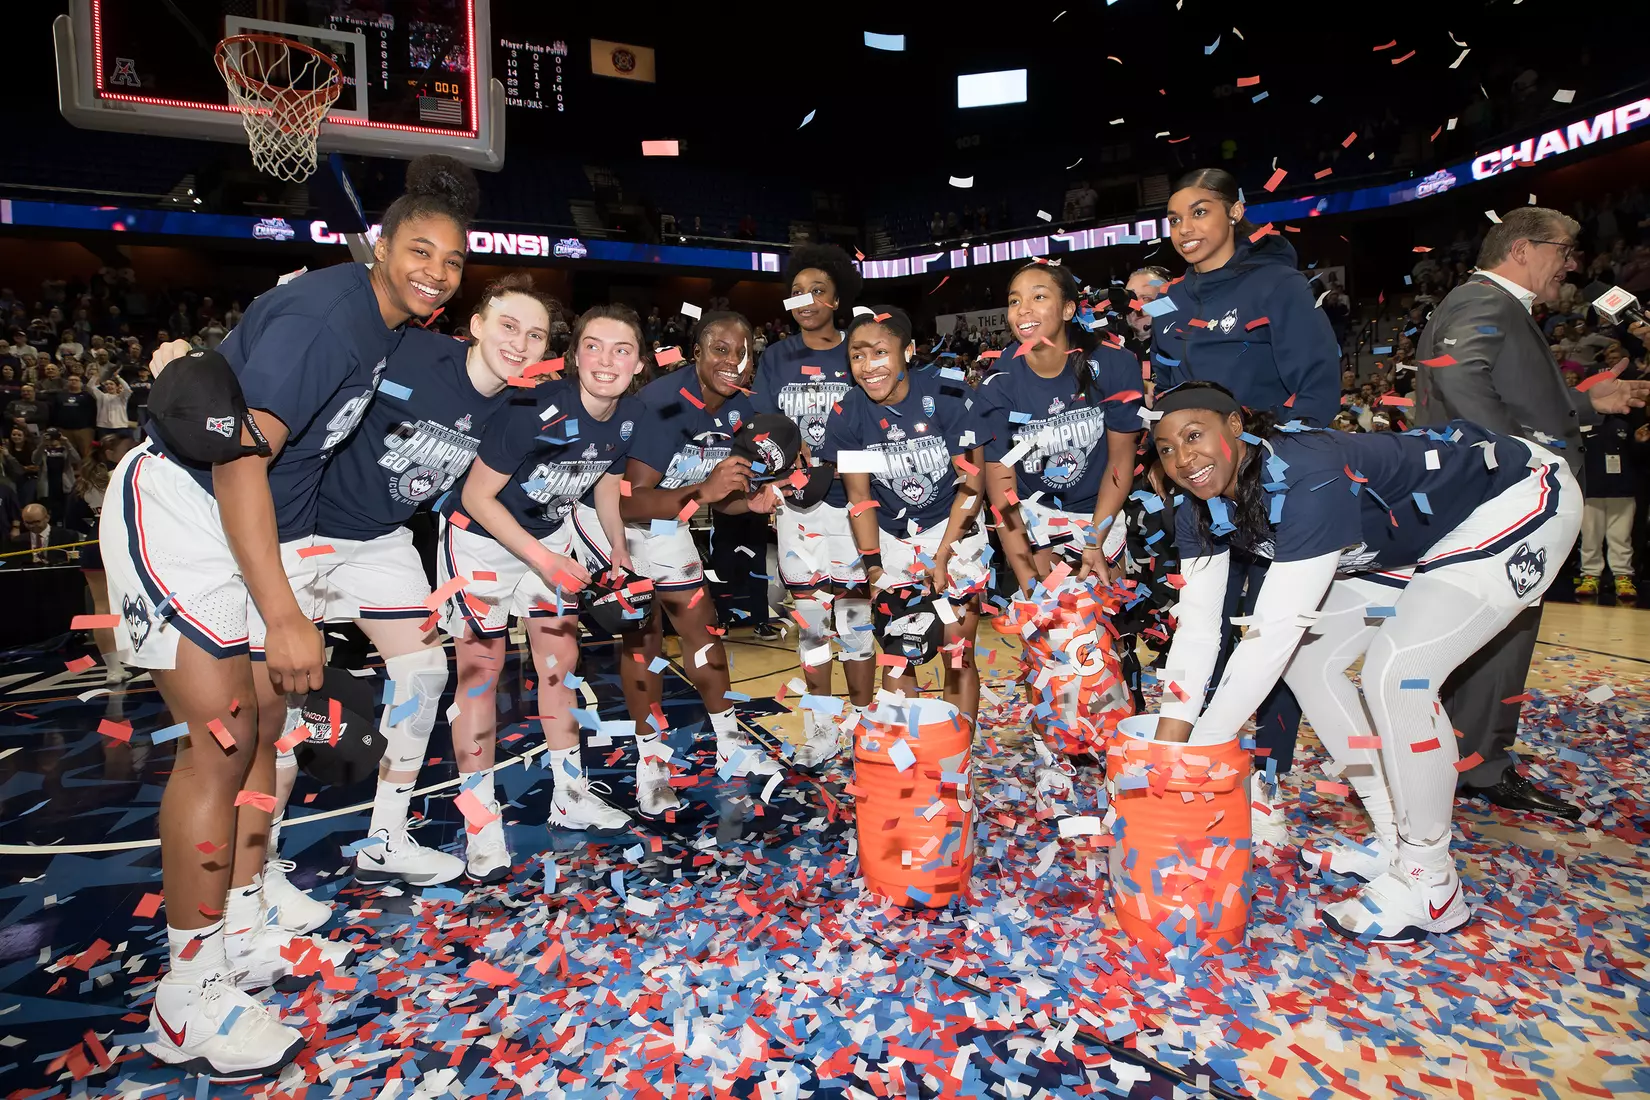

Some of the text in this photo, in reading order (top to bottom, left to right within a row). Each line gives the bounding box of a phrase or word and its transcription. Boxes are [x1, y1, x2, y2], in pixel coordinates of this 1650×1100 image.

[380, 30, 387, 39] 0
[500, 38, 524, 51] Player
[525, 42, 545, 54] Fouls
[532, 53, 539, 61] 0
[555, 56, 562, 64] 0
[507, 59, 562, 74] 10 2 0
[507, 68, 562, 83] 14 1 2
[434, 81, 459, 95] 00.0
[552, 83, 563, 92] 14
[535, 91, 539, 99] 1
[556, 94, 563, 102] 0
[557, 102, 564, 112] 3
[955, 133, 981, 151] 103
[1471, 97, 1650, 181] CHAMP
[978, 315, 997, 328] THE
[1020, 408, 1100, 433] WOMEN'S BASKETBALL
[418, 421, 449, 440] WOMEN'S
[893, 436, 944, 453] BASTBALL
[377, 449, 413, 474] 20
[1023, 460, 1042, 474] 20
[1064, 629, 1105, 677] G
